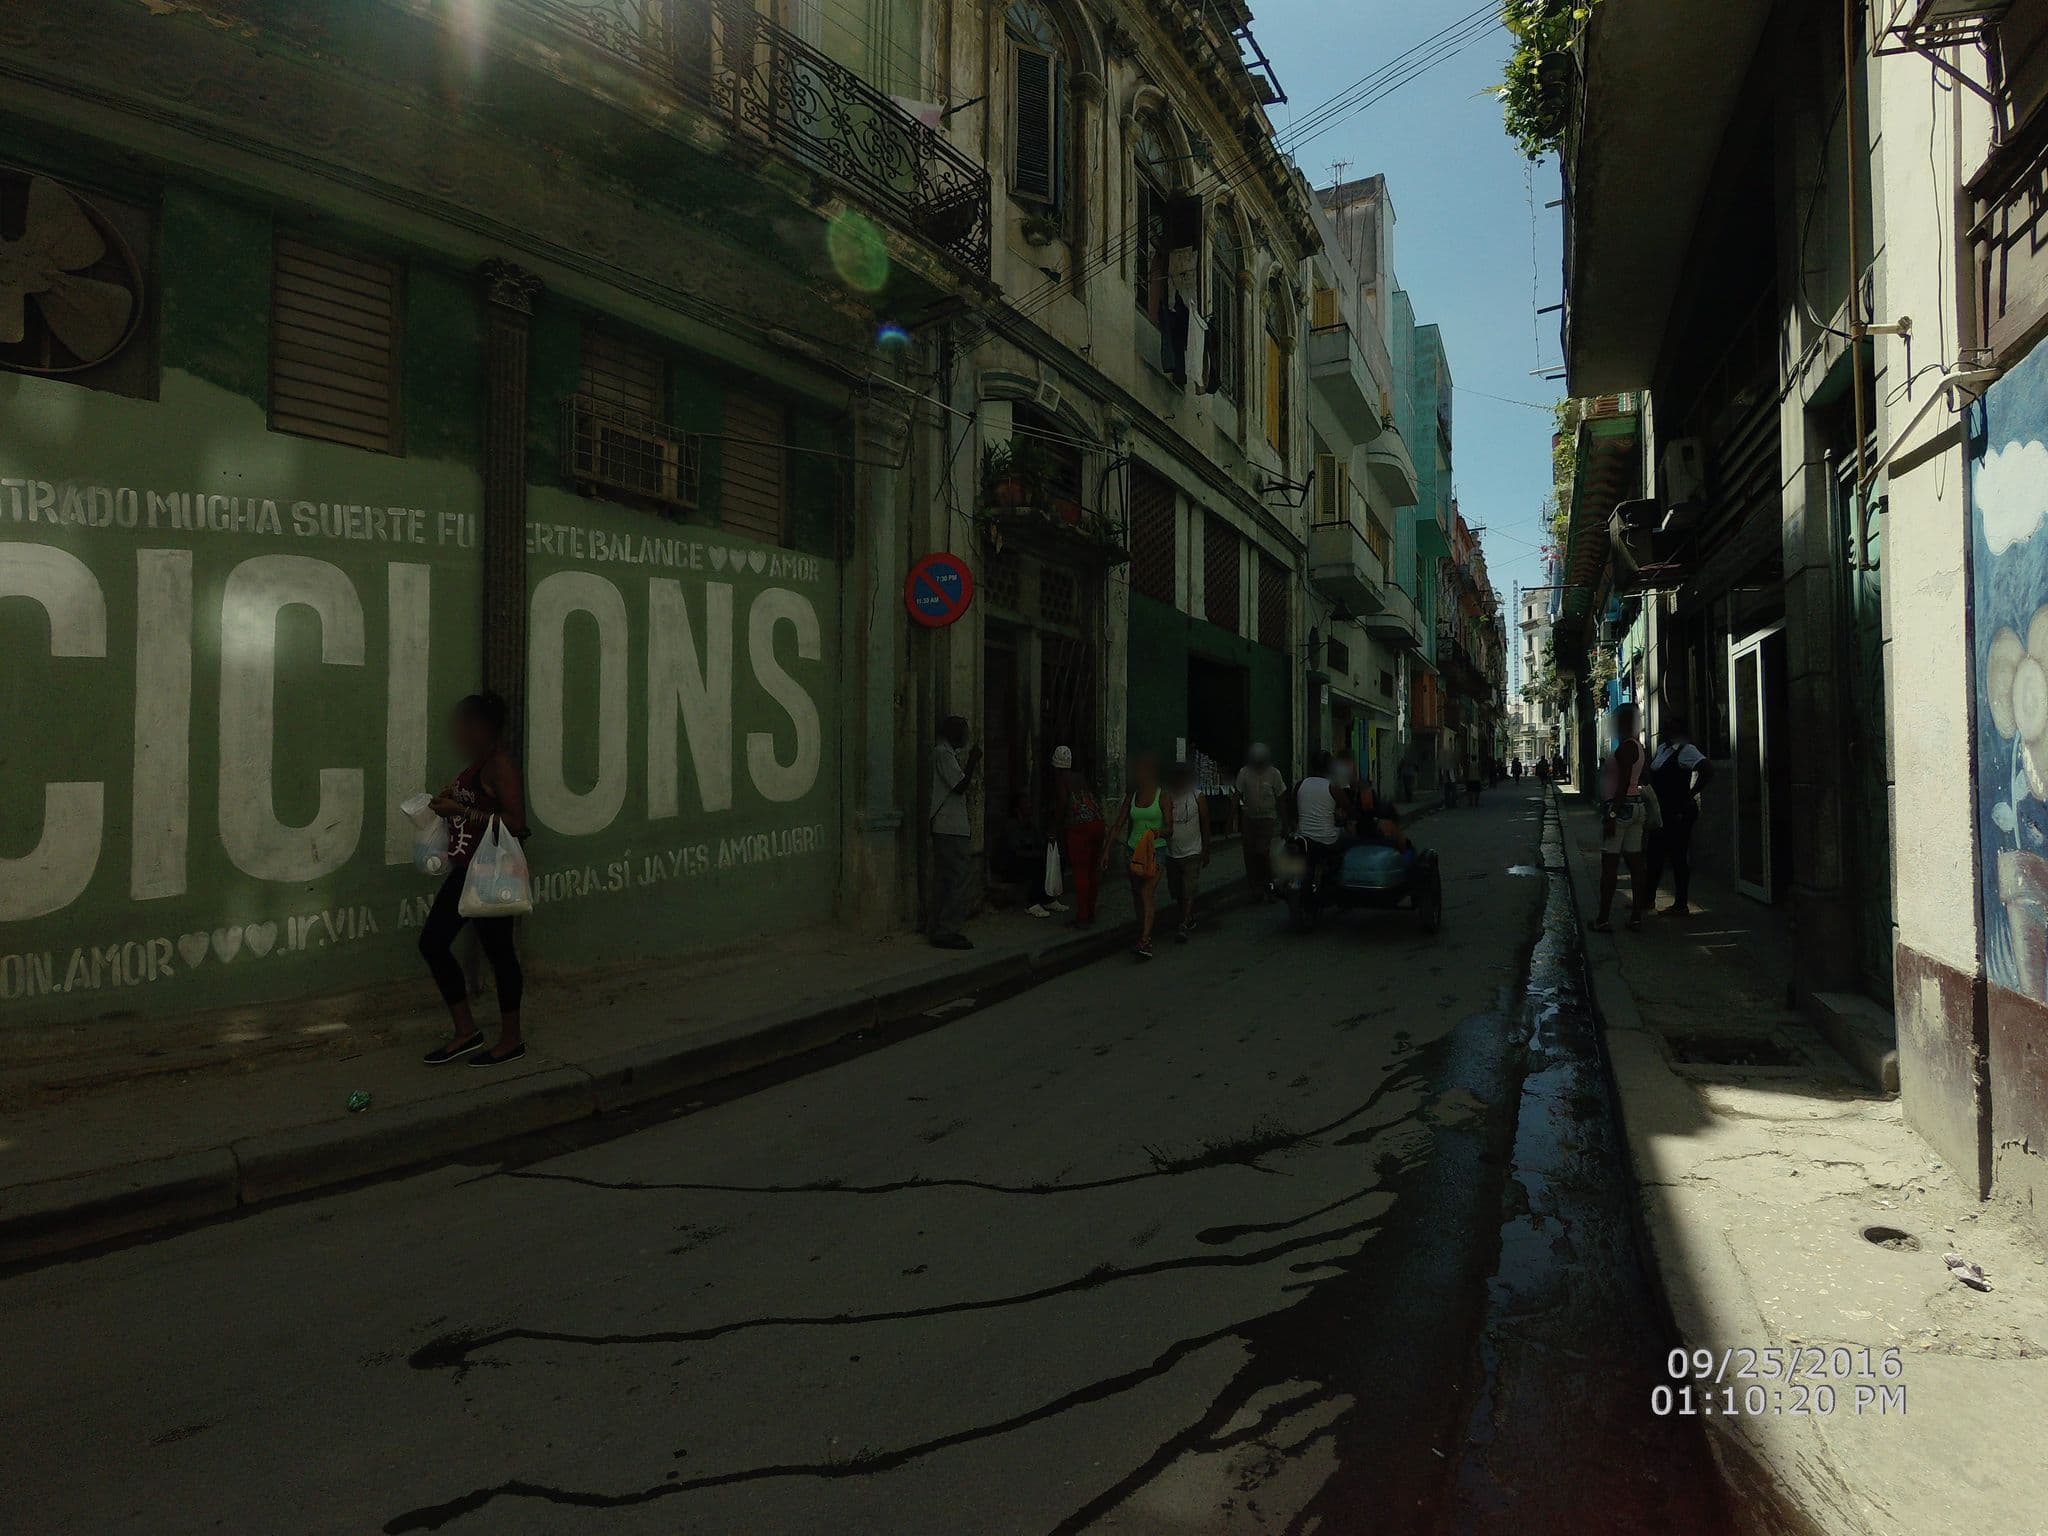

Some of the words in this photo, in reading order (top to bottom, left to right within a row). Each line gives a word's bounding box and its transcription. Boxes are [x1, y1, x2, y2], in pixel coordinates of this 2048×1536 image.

[146, 489, 283, 535] MUCHA
[291, 500, 426, 545] SUERTE
[769, 553, 819, 582] AMOR
